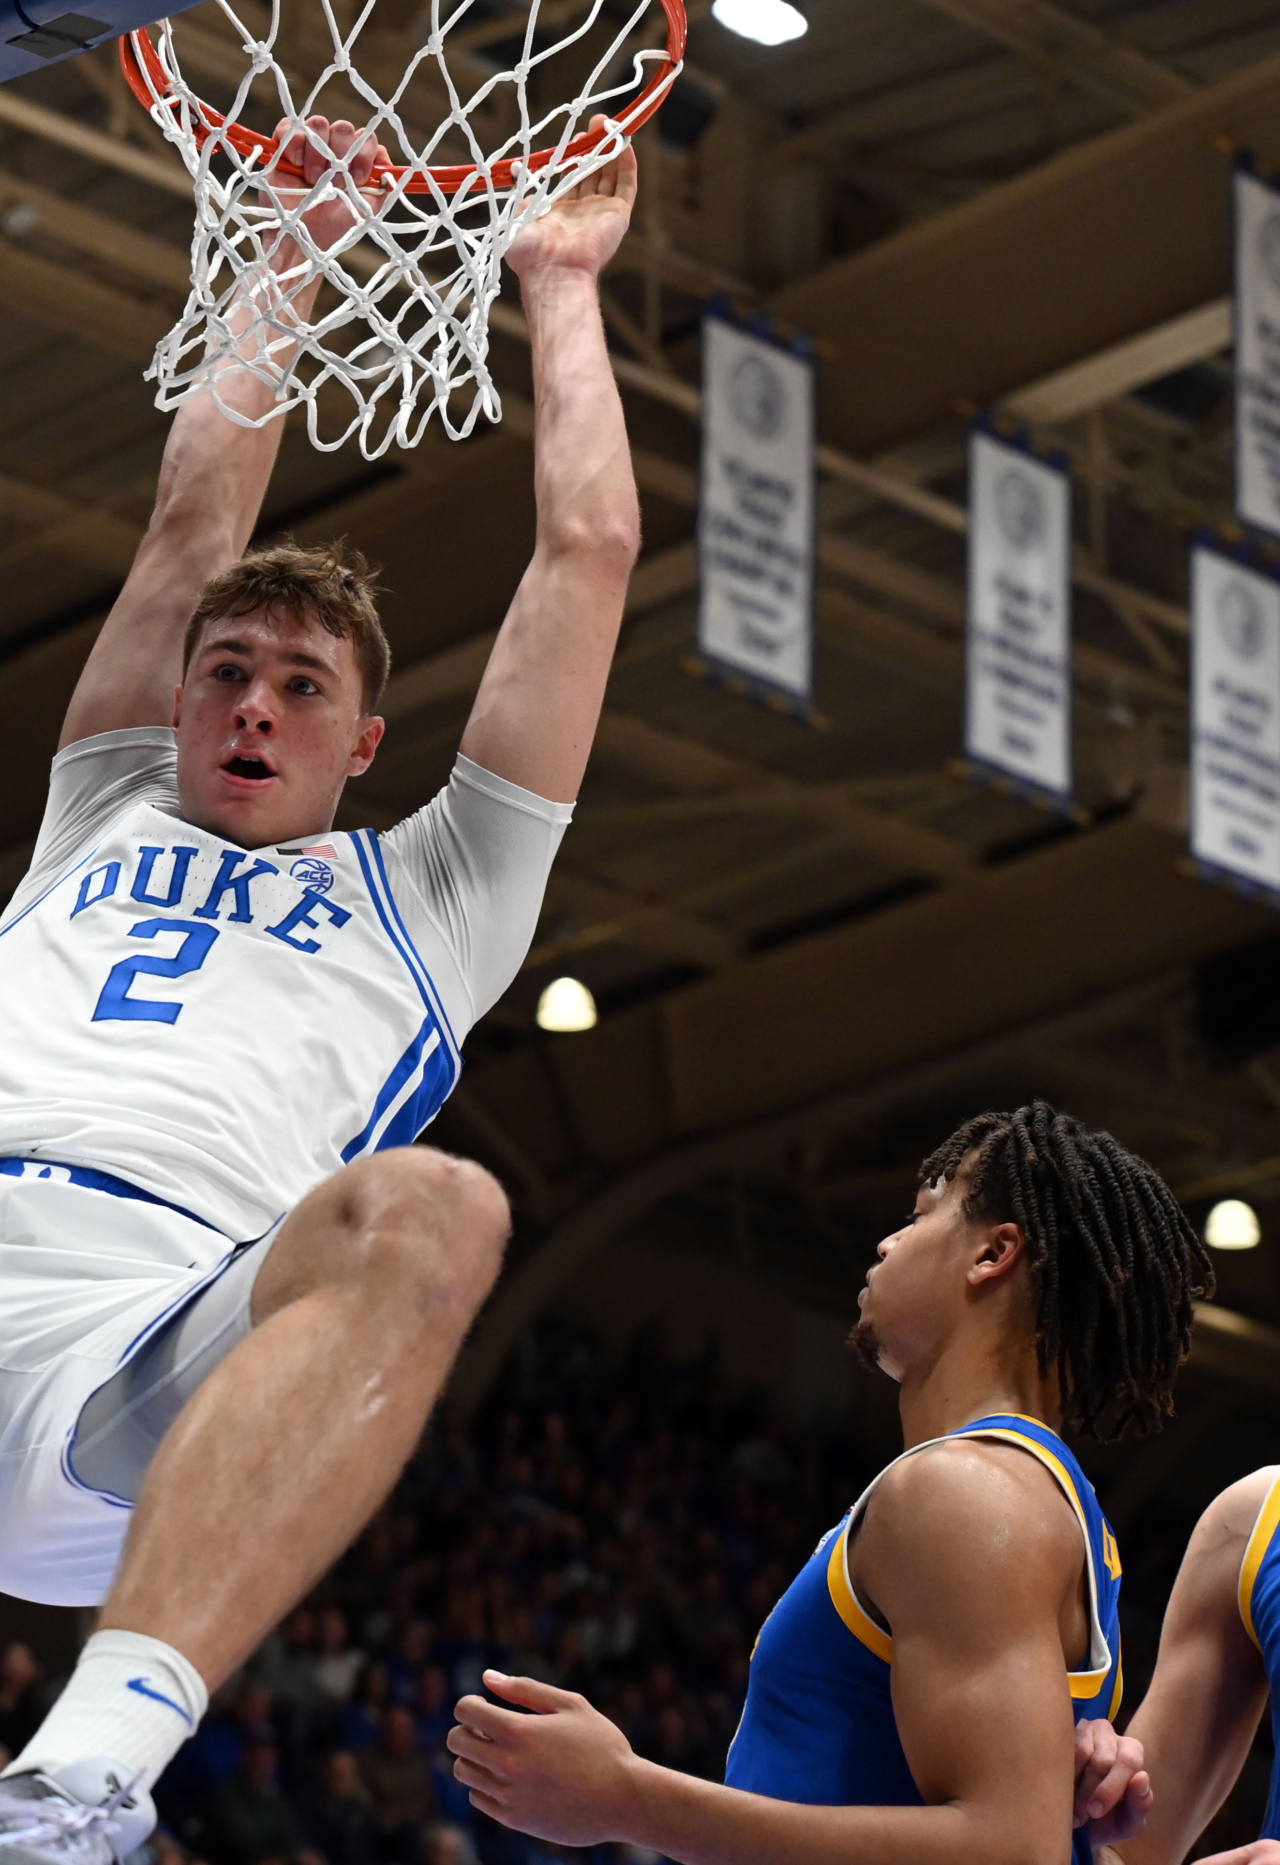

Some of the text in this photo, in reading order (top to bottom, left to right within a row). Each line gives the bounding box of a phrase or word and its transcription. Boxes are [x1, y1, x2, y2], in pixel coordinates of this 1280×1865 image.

[70, 845, 352, 954] DUKE
[296, 870, 332, 882] ACC
[91, 918, 220, 1025] 2
